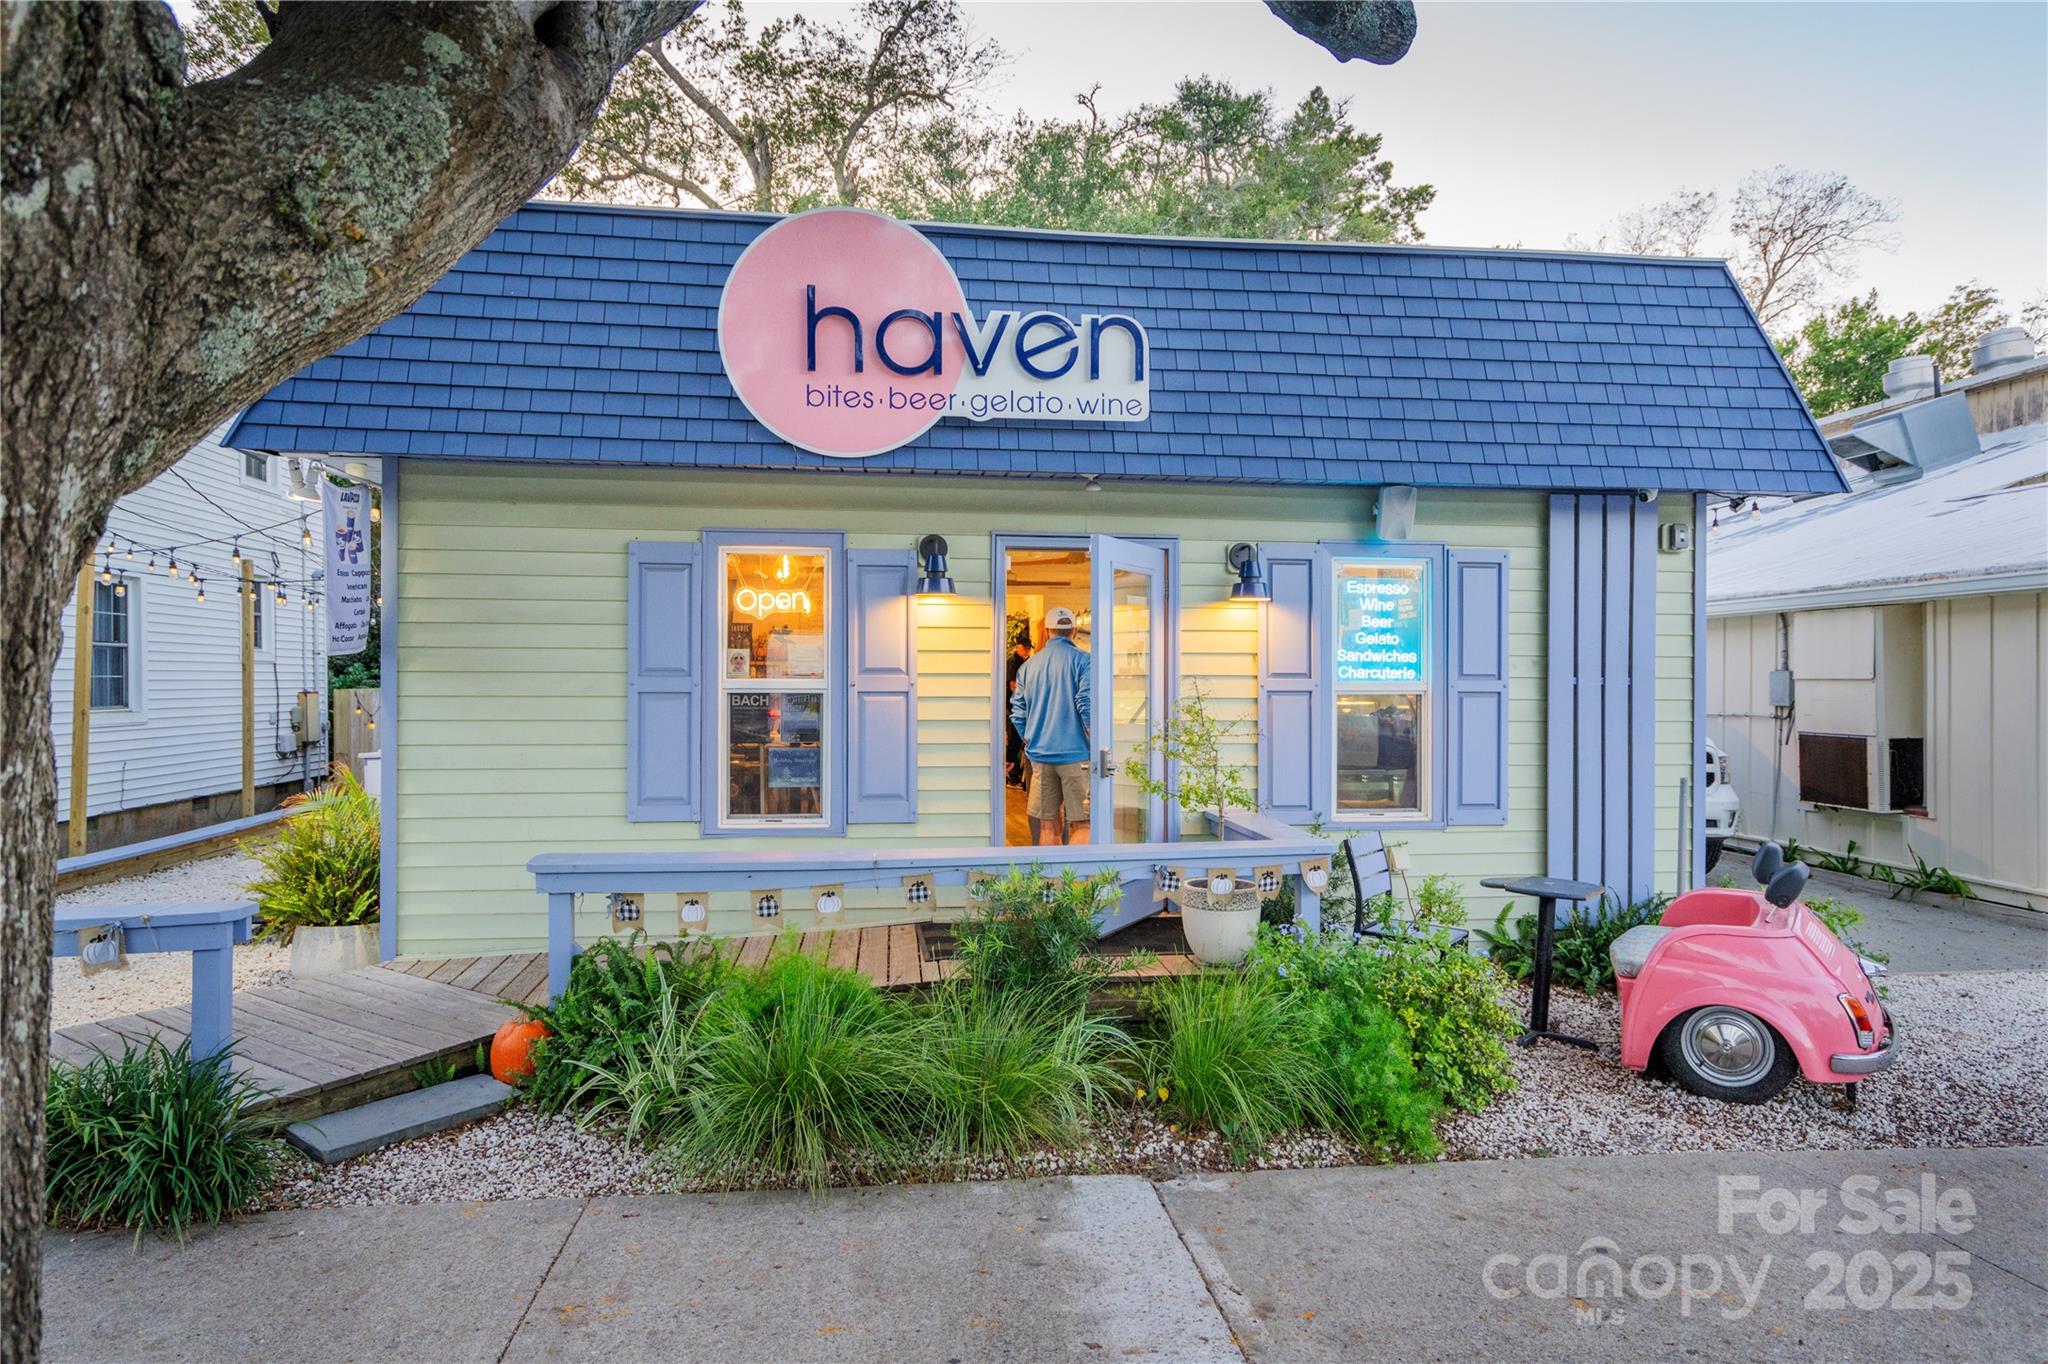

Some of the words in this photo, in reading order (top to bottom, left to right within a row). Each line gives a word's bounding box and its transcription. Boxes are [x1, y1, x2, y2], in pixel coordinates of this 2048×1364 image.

[804, 284, 1146, 382] haven
[806, 384, 874, 409] bites
[888, 386, 959, 411] beer
[970, 389, 1064, 417] gelato
[1076, 392, 1144, 416] wine
[1346, 580, 1409, 597] Espresso
[736, 588, 811, 618] Open
[1359, 598, 1395, 611] Wine
[1361, 615, 1395, 628] Beer
[1355, 631, 1400, 645] Gelato
[1337, 649, 1418, 664] Sandwiches
[1338, 665, 1417, 680] Charcuterie
[731, 695, 769, 706] BACH
